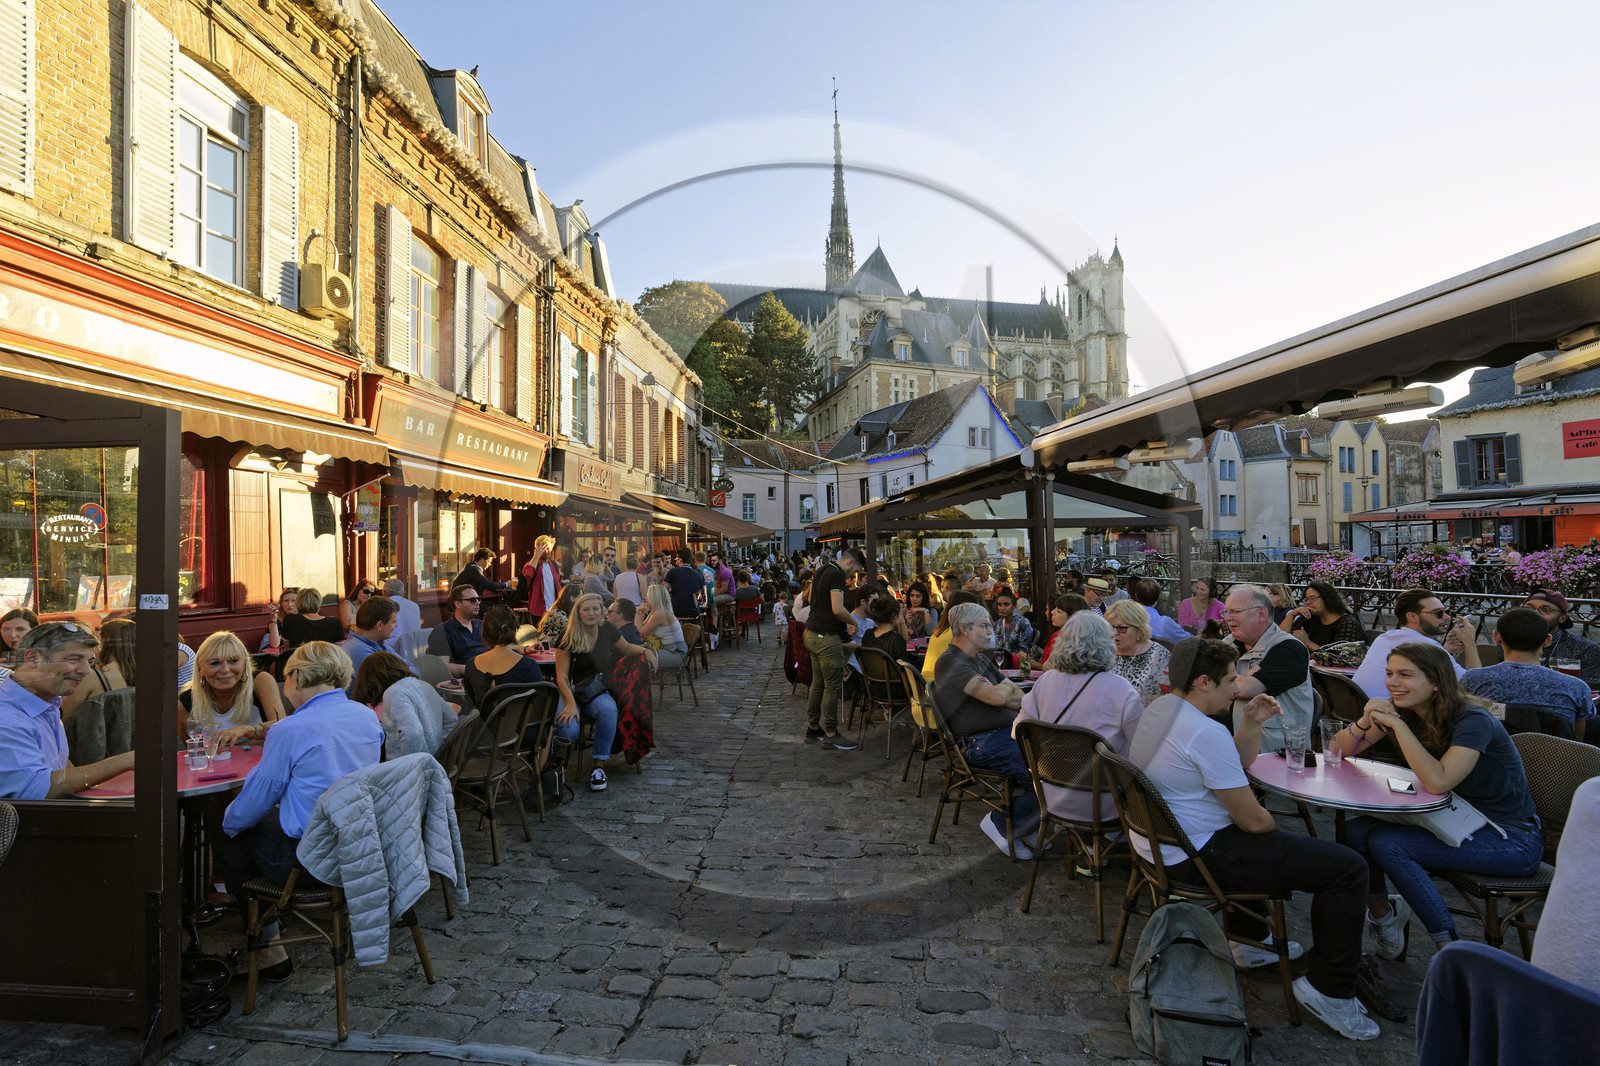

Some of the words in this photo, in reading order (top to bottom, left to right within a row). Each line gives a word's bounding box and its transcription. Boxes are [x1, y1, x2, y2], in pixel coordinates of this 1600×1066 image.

[405, 415, 435, 437] BAR
[456, 432, 529, 463] RESTAURANT
[1575, 440, 1599, 449] Café
[1538, 505, 1574, 516] Café
[48, 513, 94, 526] RESTAURANT
[46, 525, 93, 533] SERVICE
[50, 533, 90, 543] MINUIT
